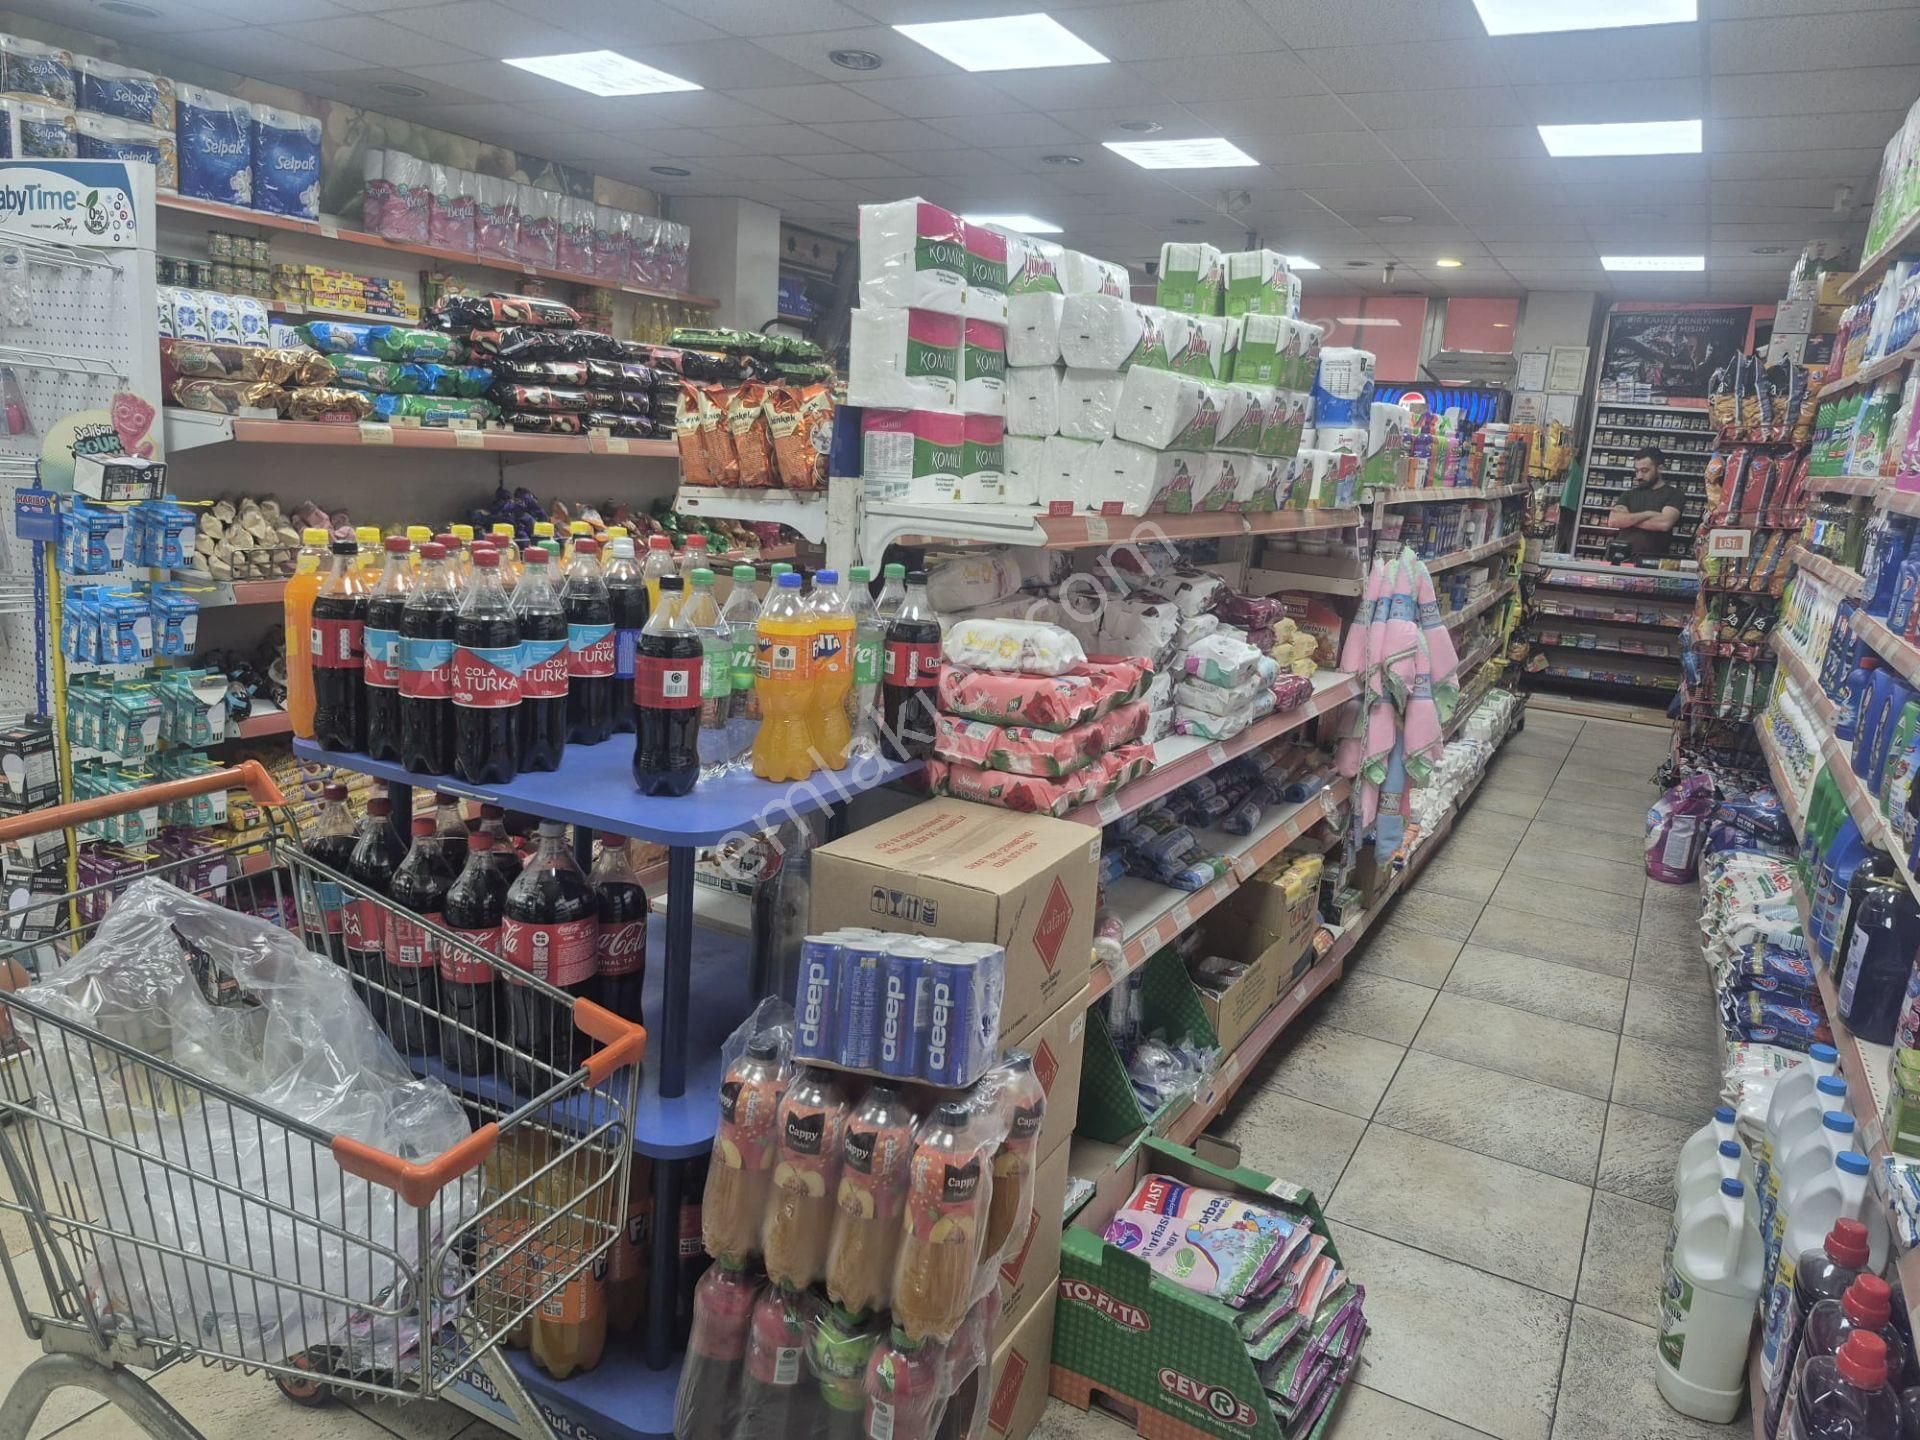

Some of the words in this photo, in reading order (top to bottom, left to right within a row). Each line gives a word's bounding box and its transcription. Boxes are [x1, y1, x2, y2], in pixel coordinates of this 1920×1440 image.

[113, 89, 151, 103] Selpak
[117, 150, 153, 162] Selpak
[202, 138, 244, 156] Selpak
[275, 155, 316, 172] Selpak
[73, 423, 113, 441] Jelibon
[73, 435, 121, 455] SOUR
[15, 494, 47, 506] HARIBO
[464, 666, 497, 678] COLA
[465, 674, 518, 692] TURKA
[800, 962, 831, 1048] deep
[881, 974, 906, 1063] deep
[927, 982, 955, 1071] deep
[787, 1124, 819, 1142] Cappy
[843, 1138, 869, 1161] Cappy
[947, 1175, 978, 1190] Cappy
[1142, 1181, 1165, 1214] PLAST
[1158, 1369, 1252, 1425] ÇEVRE
